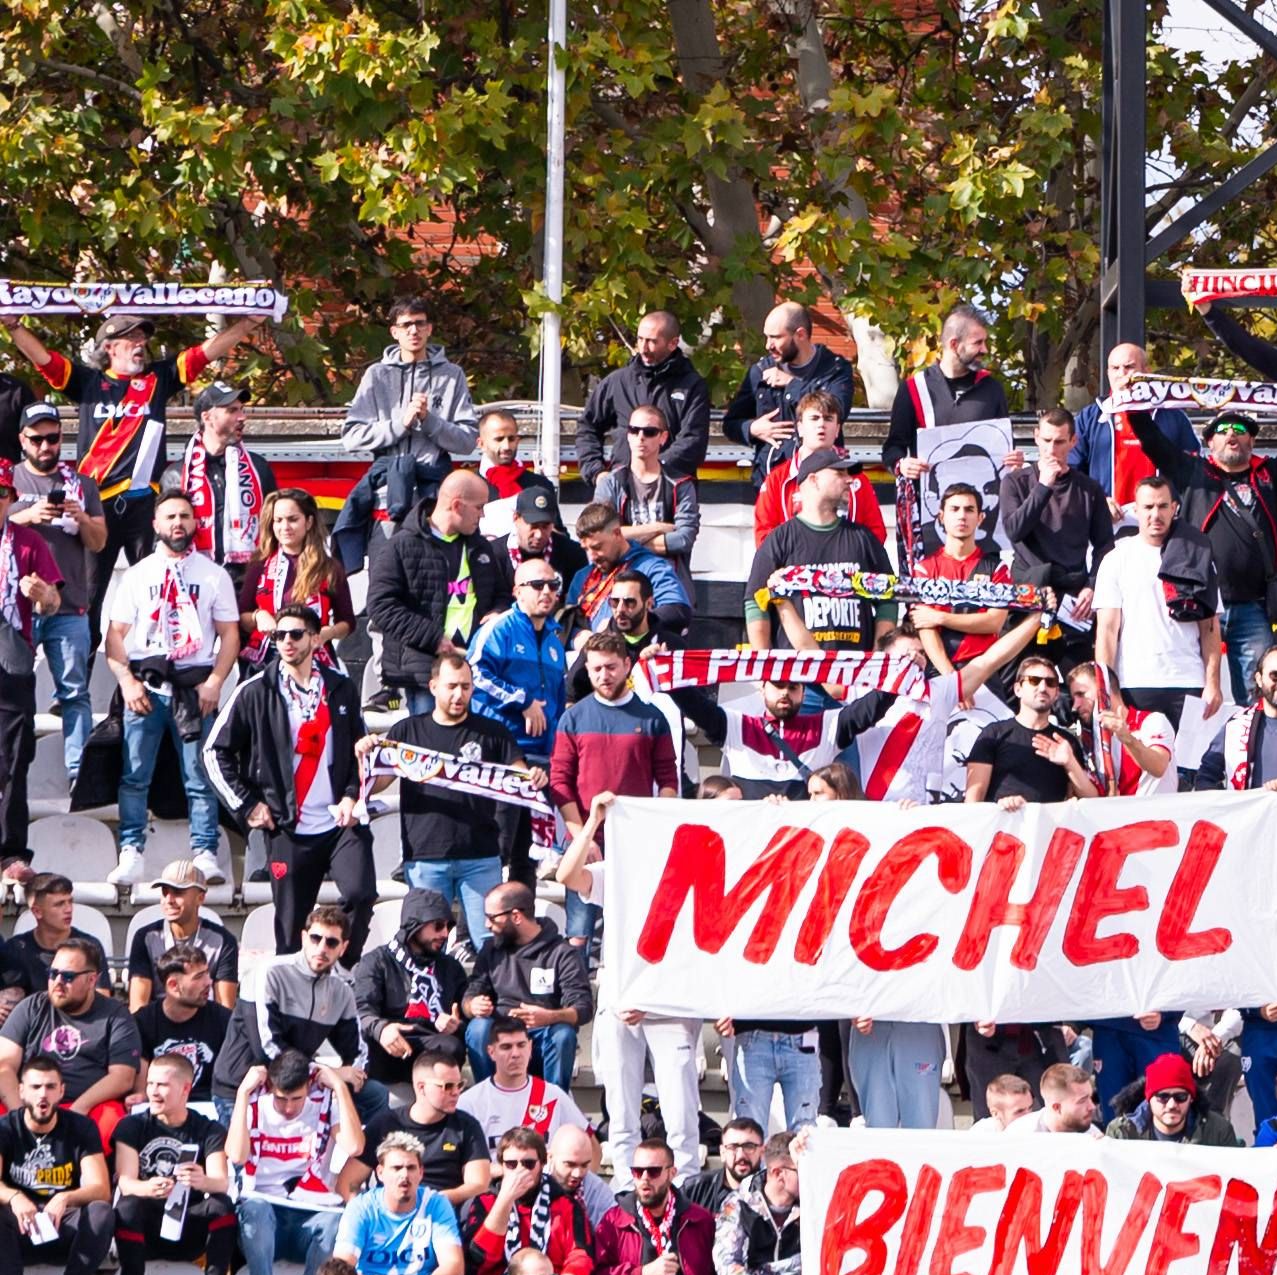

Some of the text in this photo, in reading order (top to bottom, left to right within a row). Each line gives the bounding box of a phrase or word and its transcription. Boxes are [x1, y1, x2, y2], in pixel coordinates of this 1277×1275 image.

[116, 284, 276, 307] Vallecano
[803, 596, 861, 631] DEPORTE
[708, 651, 827, 686] PUTO
[636, 819, 1233, 972] MICHEL
